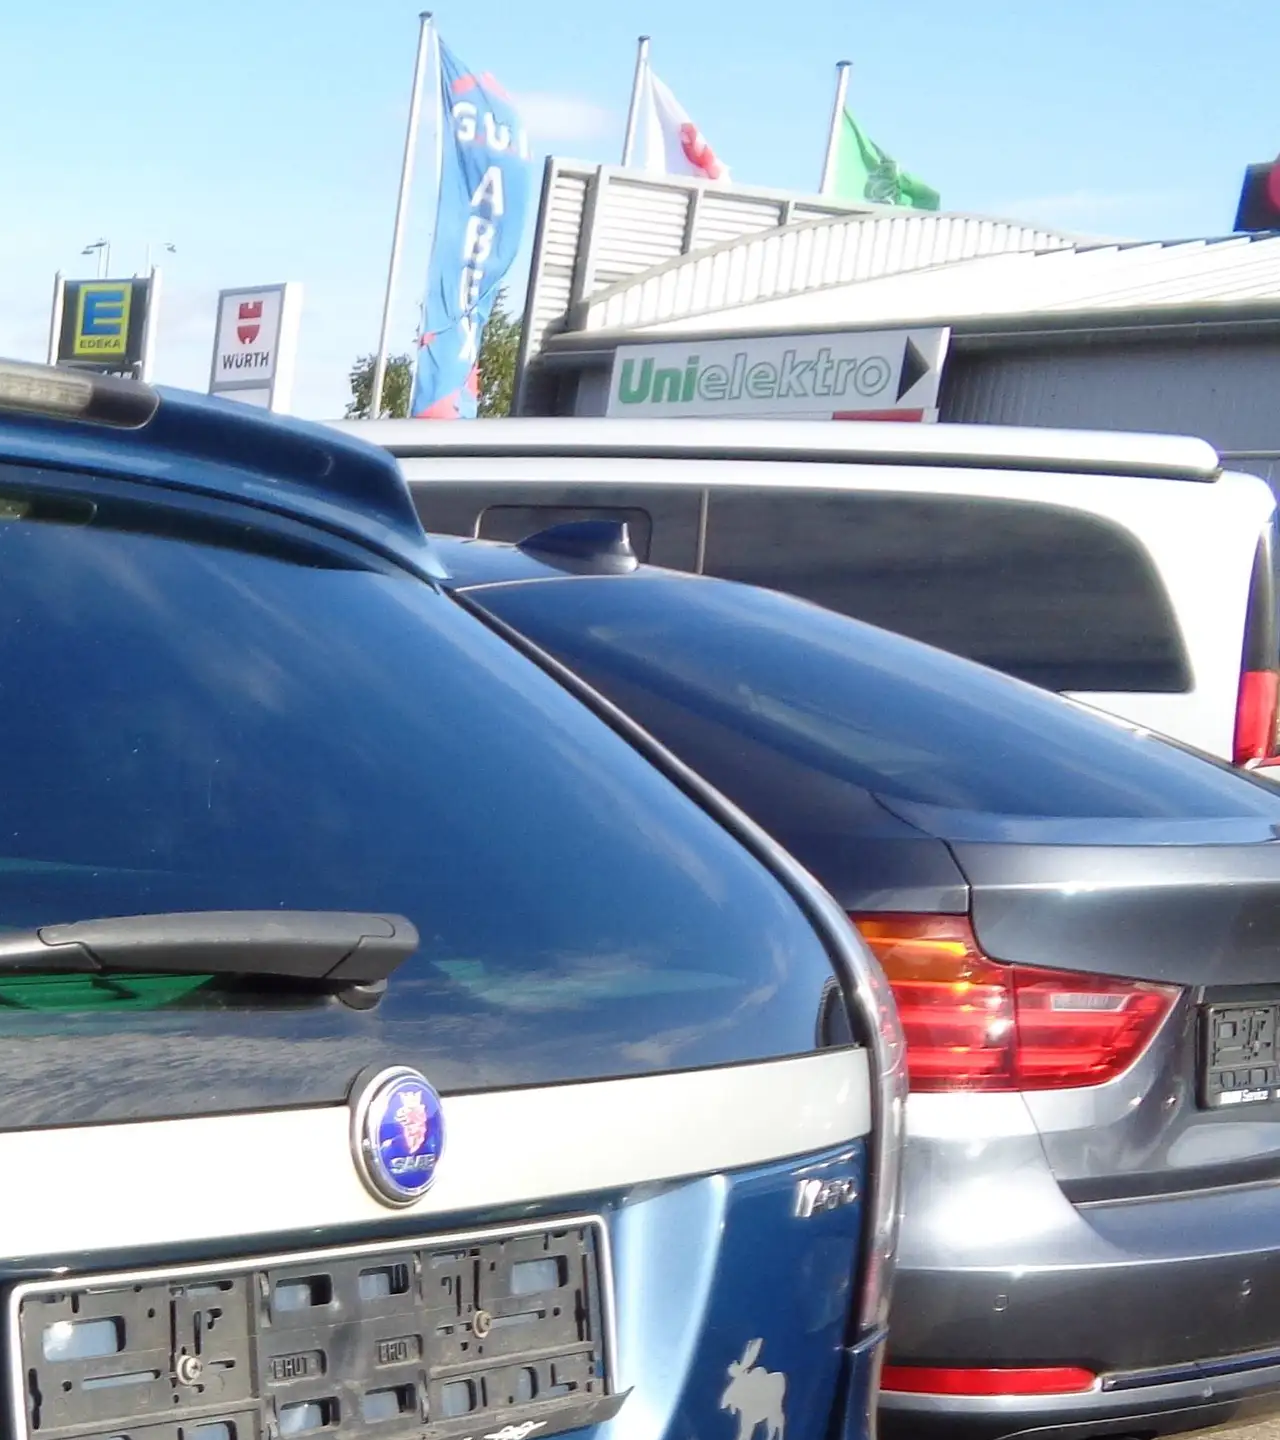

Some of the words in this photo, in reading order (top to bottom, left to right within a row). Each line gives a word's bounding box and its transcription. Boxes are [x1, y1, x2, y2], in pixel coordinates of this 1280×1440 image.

[79, 337, 122, 350] EDEKA
[222, 351, 270, 370] WÜRTH
[618, 347, 892, 405] Unielektro
